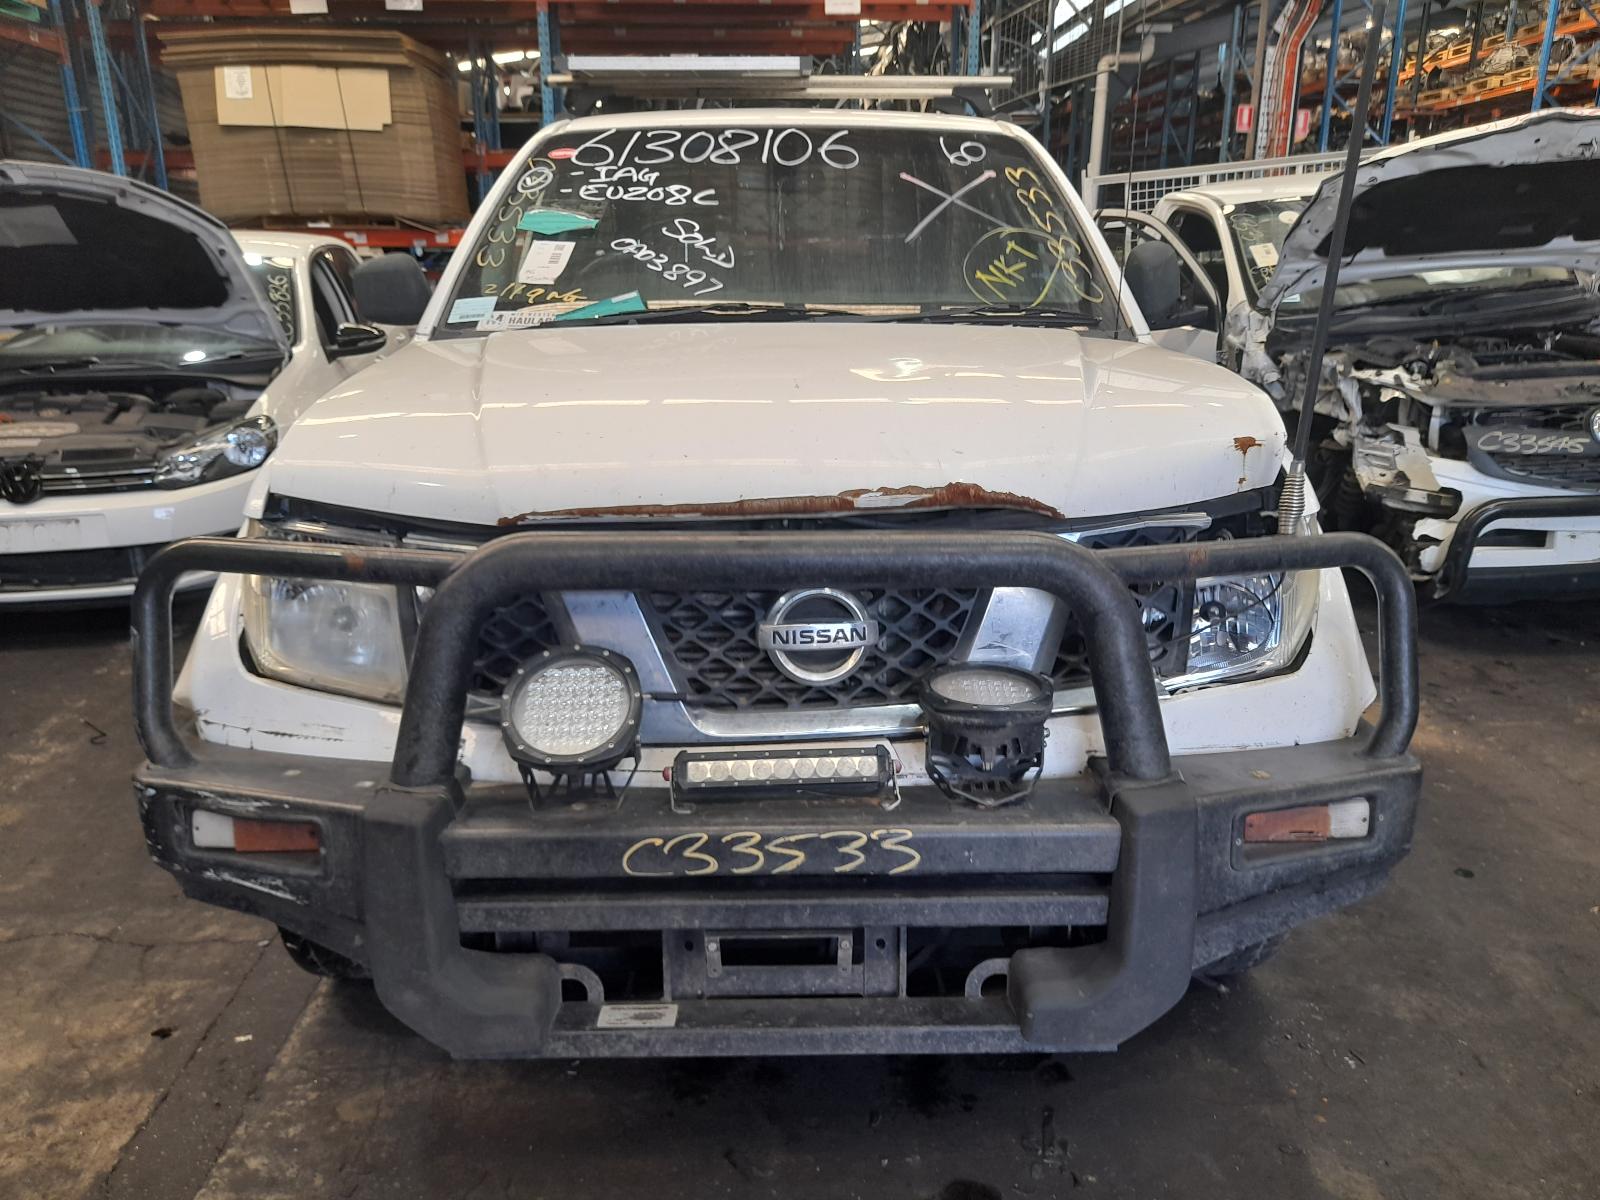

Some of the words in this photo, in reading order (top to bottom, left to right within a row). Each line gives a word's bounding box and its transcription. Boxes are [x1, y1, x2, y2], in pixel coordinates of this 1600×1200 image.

[570, 128, 859, 169] 61308106
[772, 626, 867, 645] NISSAN
[622, 829, 921, 876] C33533
